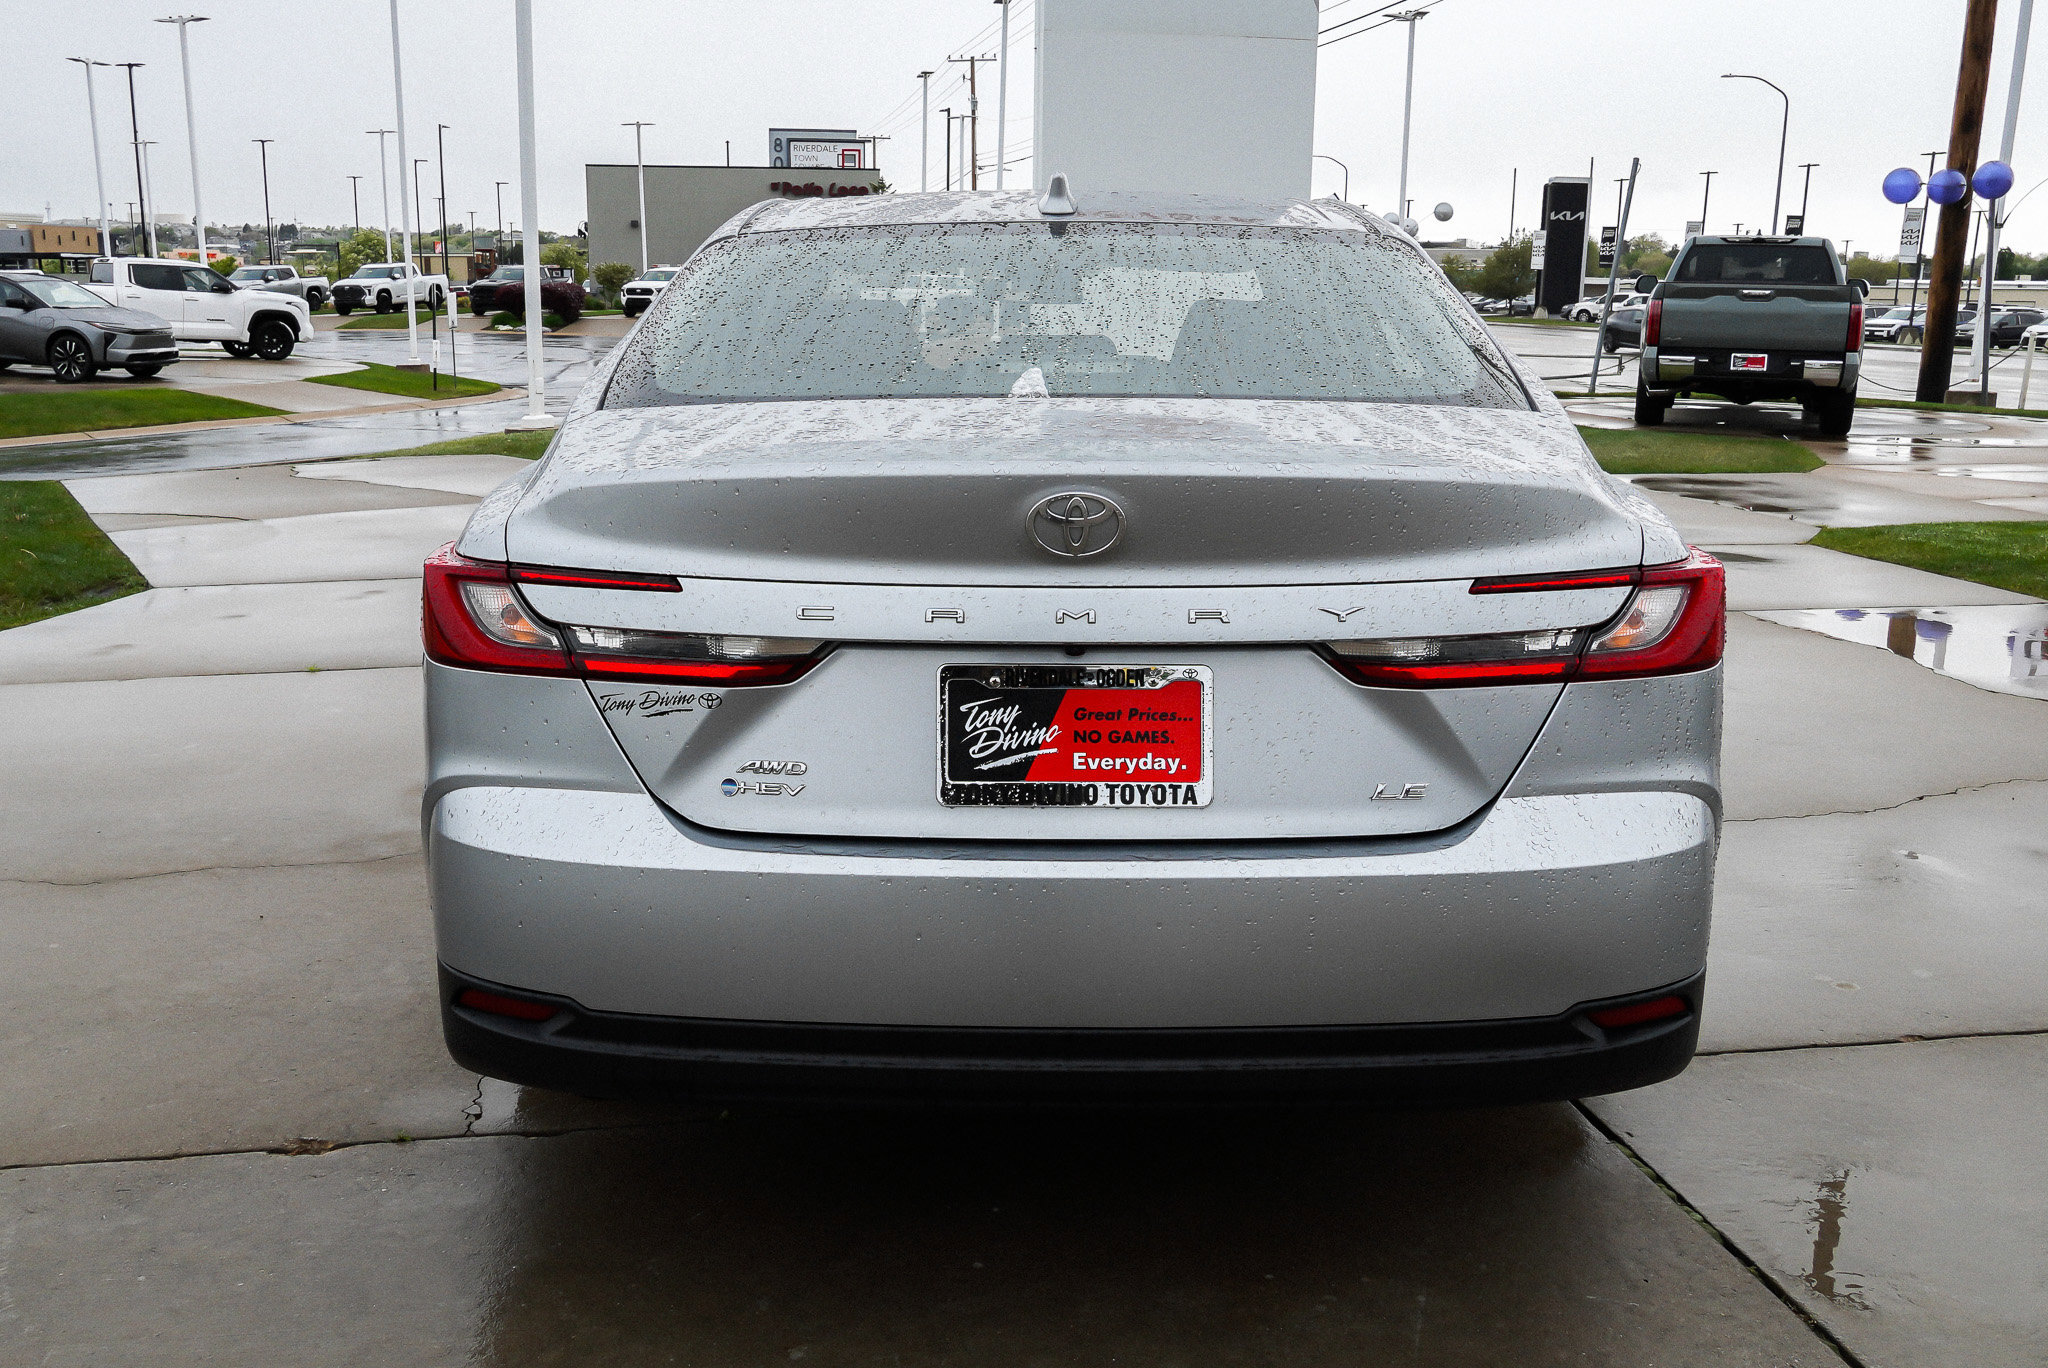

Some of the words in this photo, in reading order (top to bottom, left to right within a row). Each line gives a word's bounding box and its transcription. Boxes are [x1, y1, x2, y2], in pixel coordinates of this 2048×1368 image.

[793, 144, 838, 153] RIVERDALE
[793, 154, 819, 162] TOWN
[796, 604, 1366, 624] CAMRY
[599, 692, 637, 716] Tony
[638, 690, 697, 710] Divino
[959, 696, 1022, 733] Tony
[1073, 707, 1123, 722] Great
[1127, 707, 1194, 722] Prices...
[959, 721, 1063, 759] Divino
[1072, 729, 1101, 745] NO
[1106, 729, 1175, 745] GAMES.
[736, 759, 808, 776] AWD
[1072, 752, 1188, 775] Everyday.
[737, 780, 807, 797] HEV
[1105, 783, 1199, 806] TOYOTA
[1370, 782, 1430, 802] LE
